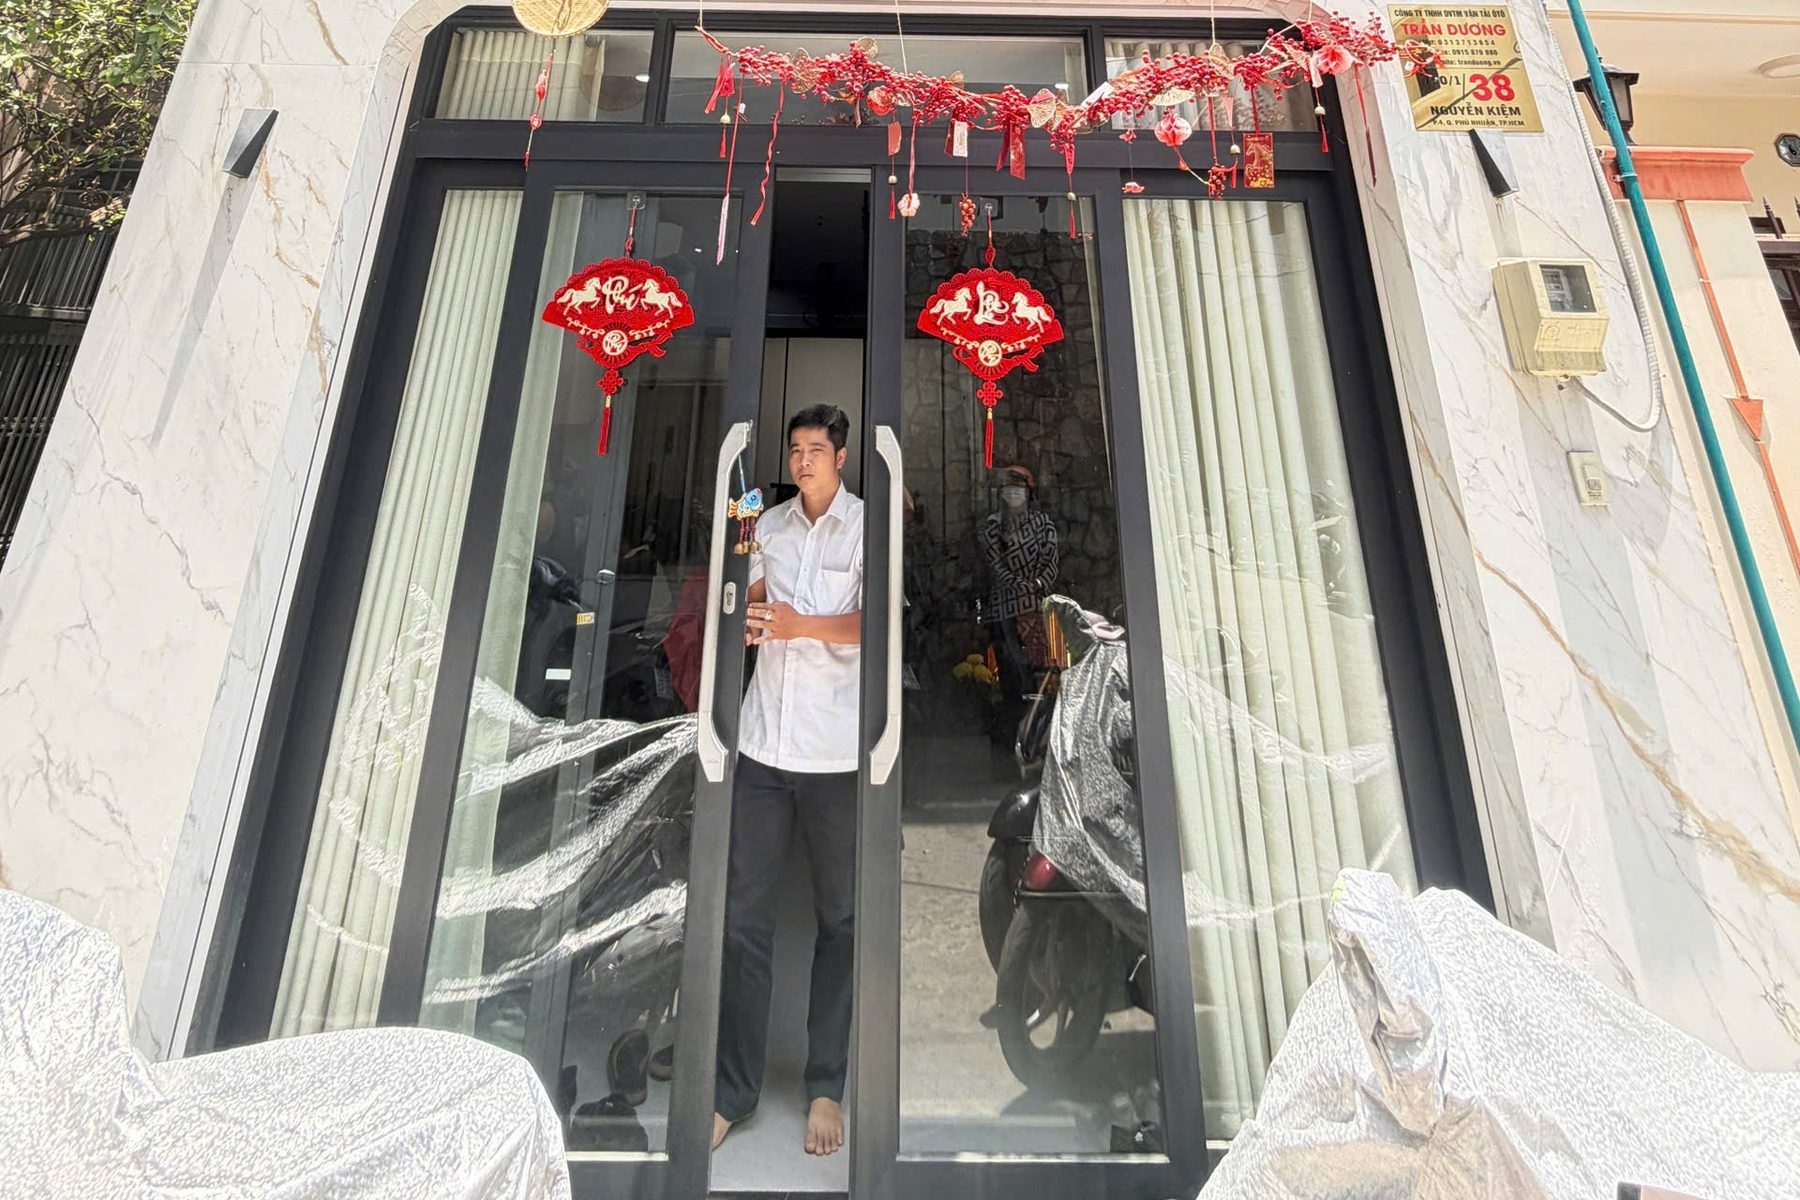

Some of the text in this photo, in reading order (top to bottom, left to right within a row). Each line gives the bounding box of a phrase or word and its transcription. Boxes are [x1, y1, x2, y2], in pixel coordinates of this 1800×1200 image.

[1394, 8, 1413, 17] CÔNG
[1414, 9, 1422, 17] TY
[1424, 9, 1442, 17] TNHH
[1446, 22, 1506, 36] DƯƠNG
[1469, 73, 1515, 102] 38
[1430, 102, 1521, 119] NGUYỄN KIỆM
